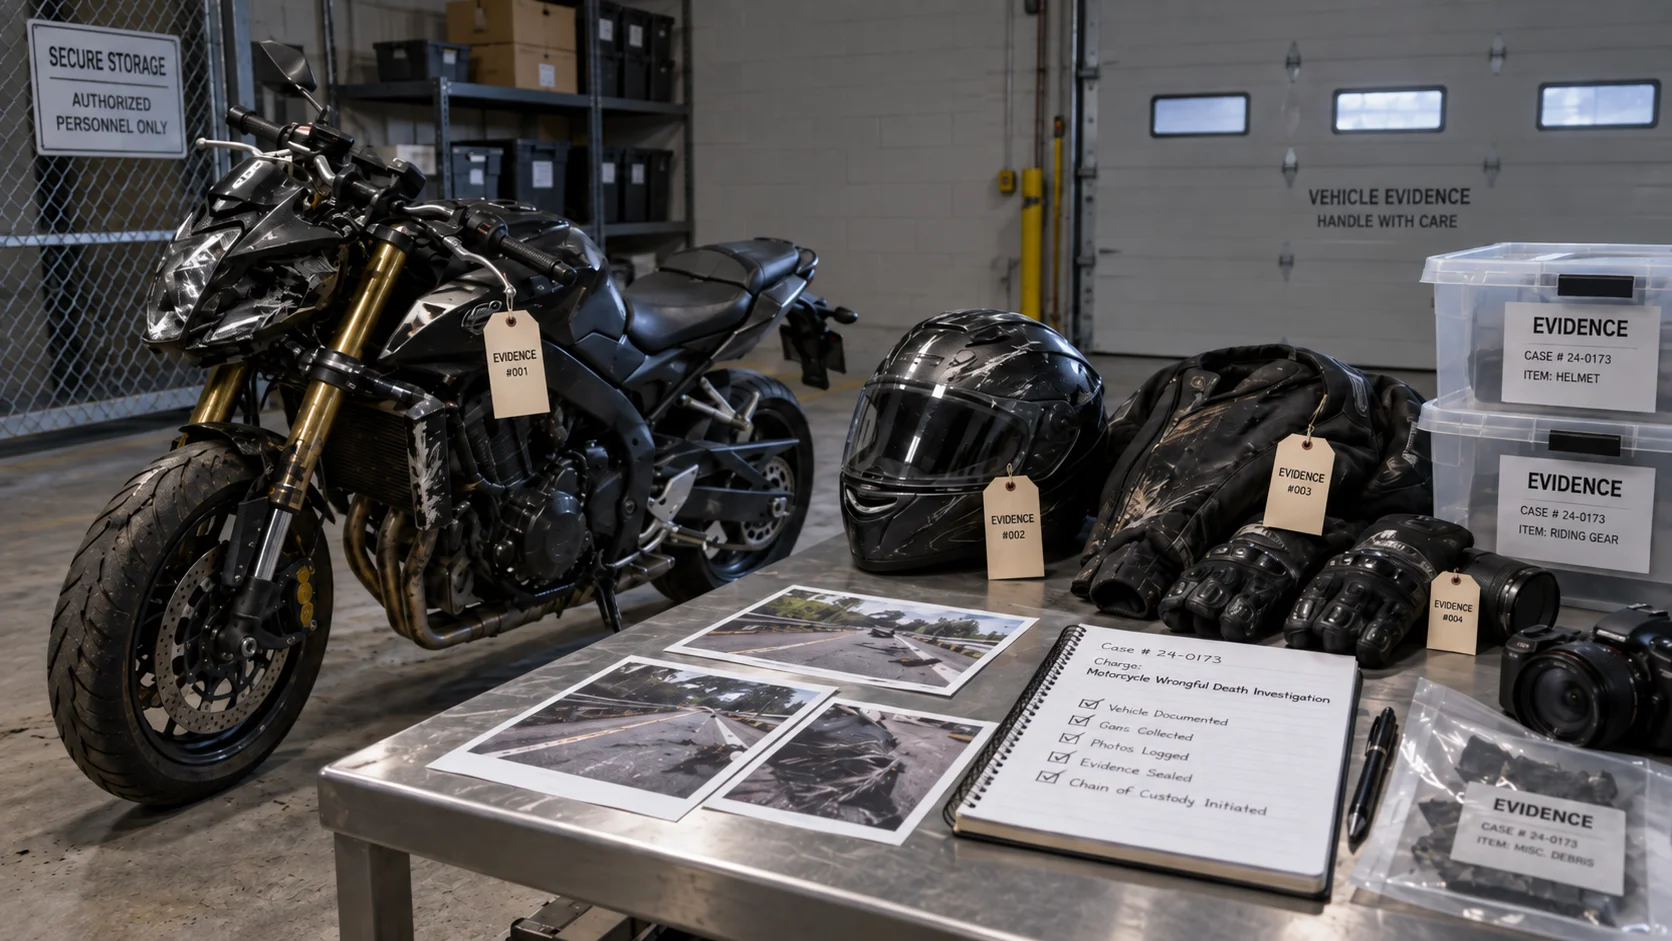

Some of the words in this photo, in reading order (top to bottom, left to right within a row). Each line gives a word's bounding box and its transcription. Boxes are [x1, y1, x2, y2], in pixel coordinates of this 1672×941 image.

[49, 46, 104, 70] SECURE
[108, 51, 166, 76] STORAGE
[72, 92, 151, 111] AUTHORIZED
[56, 115, 134, 134] PERSONNEL
[136, 119, 167, 134] ONLY
[1309, 188, 1379, 205] VEHICLE
[1385, 188, 1471, 205] EVIDENCE
[1317, 214, 1373, 228] HANDLE
[1378, 214, 1415, 228] WITH
[1419, 214, 1458, 229] CARE
[1533, 316, 1629, 337] EVIDENCE
[493, 349, 537, 363] EVIDENCE
[1524, 350, 1553, 362] CASE
[1557, 353, 1564, 362] #
[1567, 353, 1612, 365] 24-0173
[506, 367, 528, 377] #001
[1523, 370, 1552, 381] ITEM:
[1556, 372, 1600, 384] HELMET
[1278, 467, 1325, 483] EVIDENCE
[1287, 484, 1312, 496] #003
[1528, 472, 1623, 498] EVIDENCE
[991, 513, 1035, 525] EVIDENCE
[1520, 505, 1548, 518] CASE
[1552, 509, 1559, 518] #
[1562, 511, 1606, 524] 24-0173
[1002, 530, 1026, 540] #002
[1518, 524, 1547, 537] ITEM:
[1550, 528, 1586, 541] RIDING
[1589, 532, 1619, 545] GEAR
[1434, 599, 1473, 612] EVIDENCE
[1442, 614, 1463, 623] #004
[1101, 642, 1135, 654] Case
[1141, 648, 1151, 656] #
[1156, 649, 1222, 664] 24-0173
[1094, 657, 1142, 671] Charge:
[1086, 667, 1151, 684] Motorcycle
[1156, 676, 1210, 690] Wrongful
[1213, 682, 1249, 695] Death
[1253, 687, 1331, 705] Investigation
[1109, 704, 1149, 717] Vehicle
[1154, 709, 1229, 727] Documented
[1137, 727, 1194, 742] Collected
[1090, 739, 1134, 754] Photos
[1142, 746, 1190, 762] Logged
[1080, 758, 1140, 776] Evidence
[1146, 769, 1193, 783] Sealed
[1069, 778, 1109, 793] Chain
[1116, 786, 1134, 796] of
[1139, 789, 1196, 808] Custody
[1204, 798, 1267, 817] Initiated
[1493, 798, 1594, 830] EVIDENCE
[1481, 822, 1514, 836] CASE
[1530, 831, 1578, 849] 24-0173
[1477, 835, 1509, 850] ITEM:
[1514, 843, 1547, 858] MISC.
[1551, 850, 1595, 868] DEBRIS
